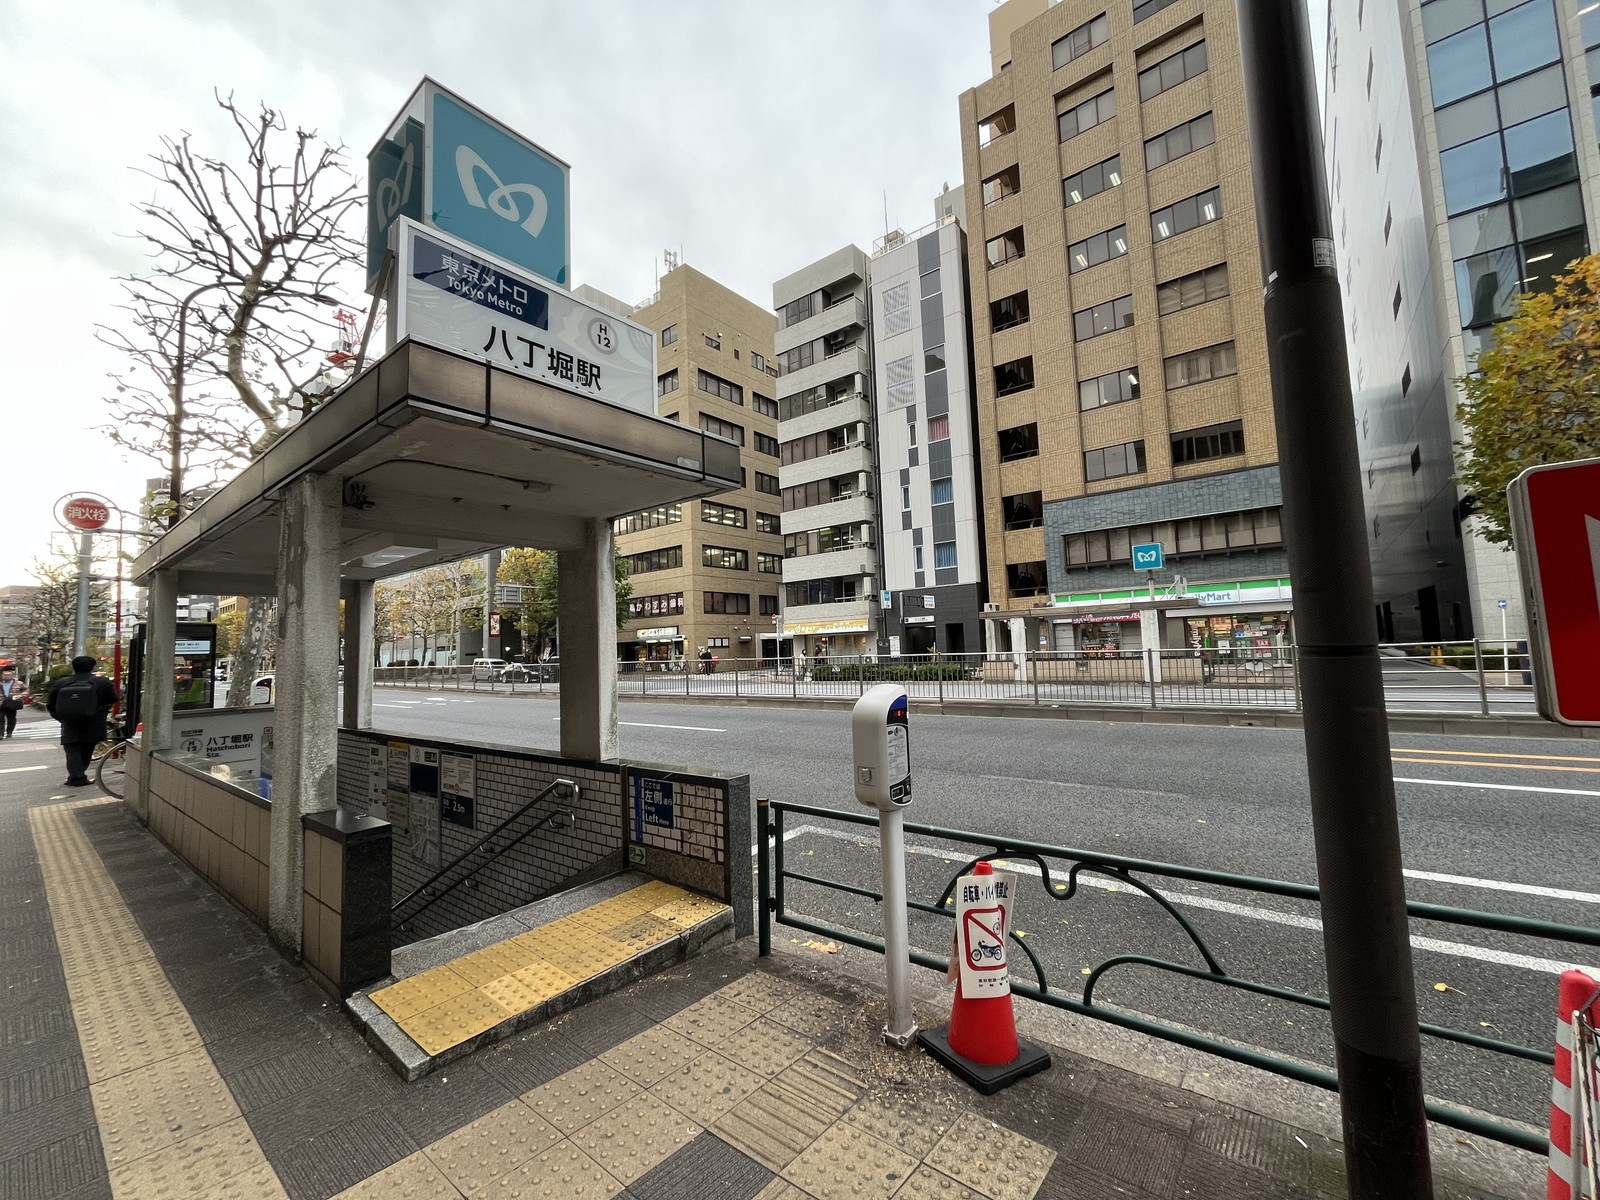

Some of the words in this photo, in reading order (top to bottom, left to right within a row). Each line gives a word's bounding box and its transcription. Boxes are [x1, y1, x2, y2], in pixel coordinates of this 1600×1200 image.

[441, 253, 528, 304] 東京メトロ
[446, 274, 485, 300] Tokyo
[487, 291, 523, 316] Metro
[599, 323, 608, 335] H
[596, 333, 612, 349] 12
[483, 325, 603, 393] 八丁堀駅
[67, 505, 108, 522] 消火栓
[206, 733, 254, 746] 八丁堀駅
[645, 813, 659, 824] Left
